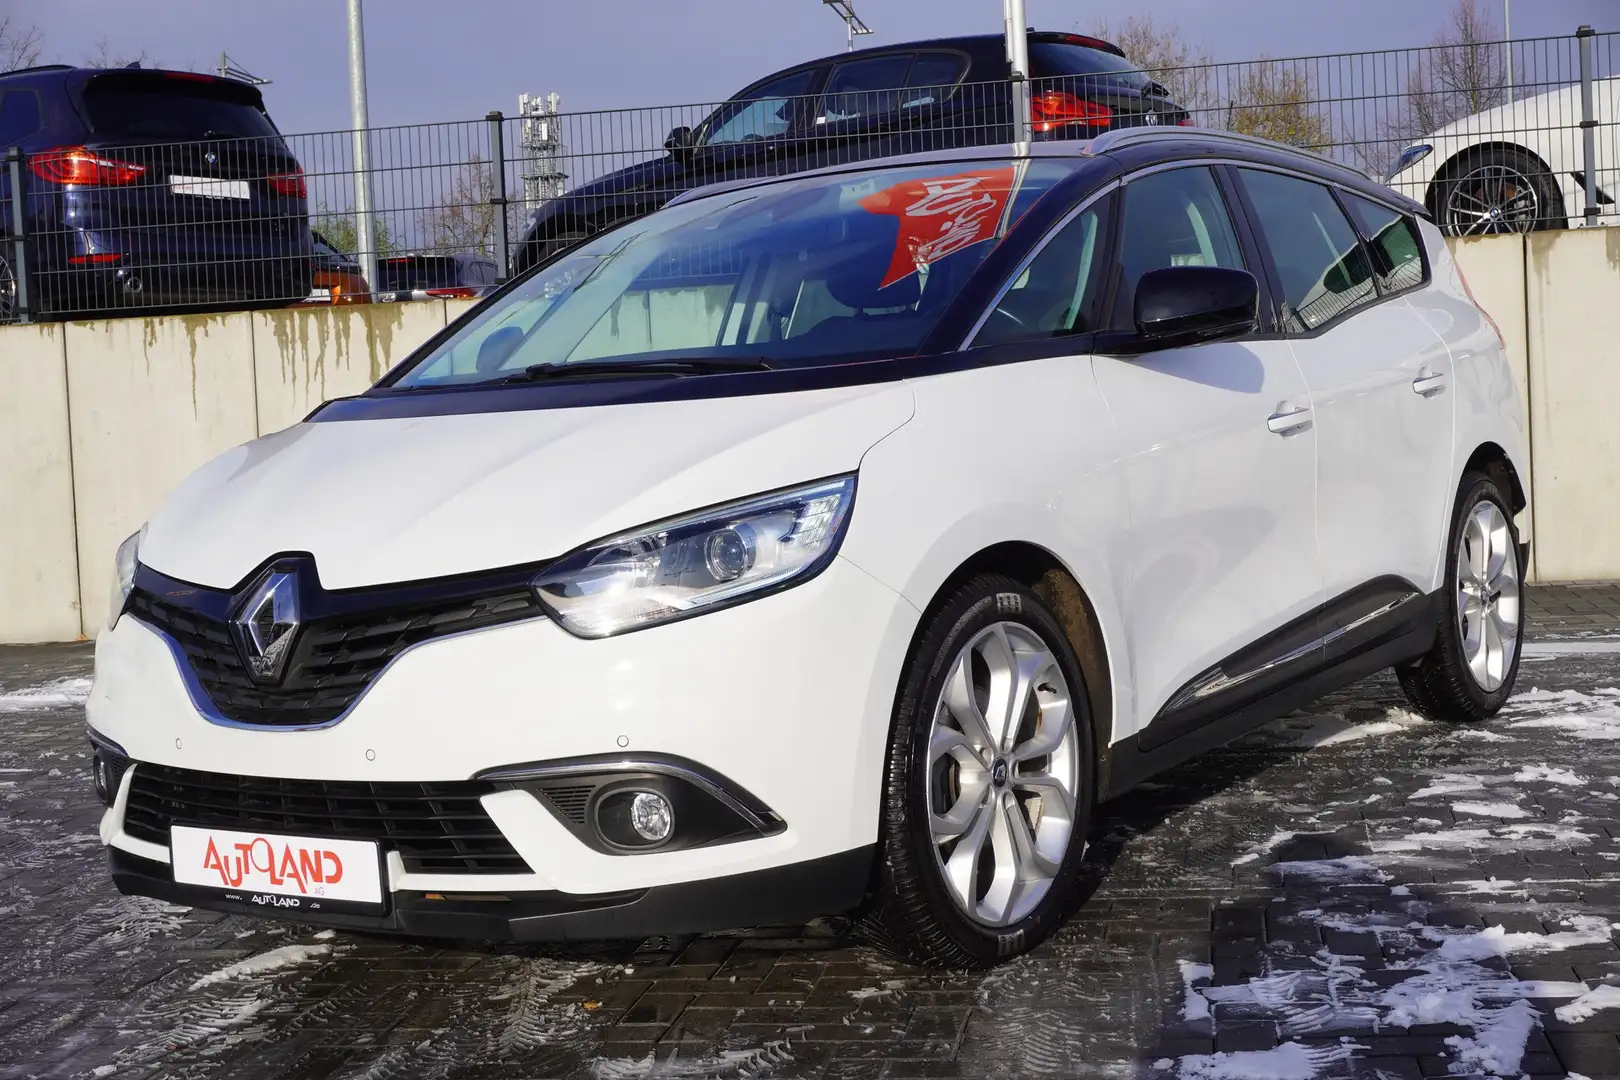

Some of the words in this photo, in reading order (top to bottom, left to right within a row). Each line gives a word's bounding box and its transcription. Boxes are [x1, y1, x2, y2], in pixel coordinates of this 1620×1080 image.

[203, 835, 343, 894] AUTOLAND
[314, 886, 325, 896] AG
[225, 893, 243, 901] www.
[251, 894, 300, 908] AUTOLAND
